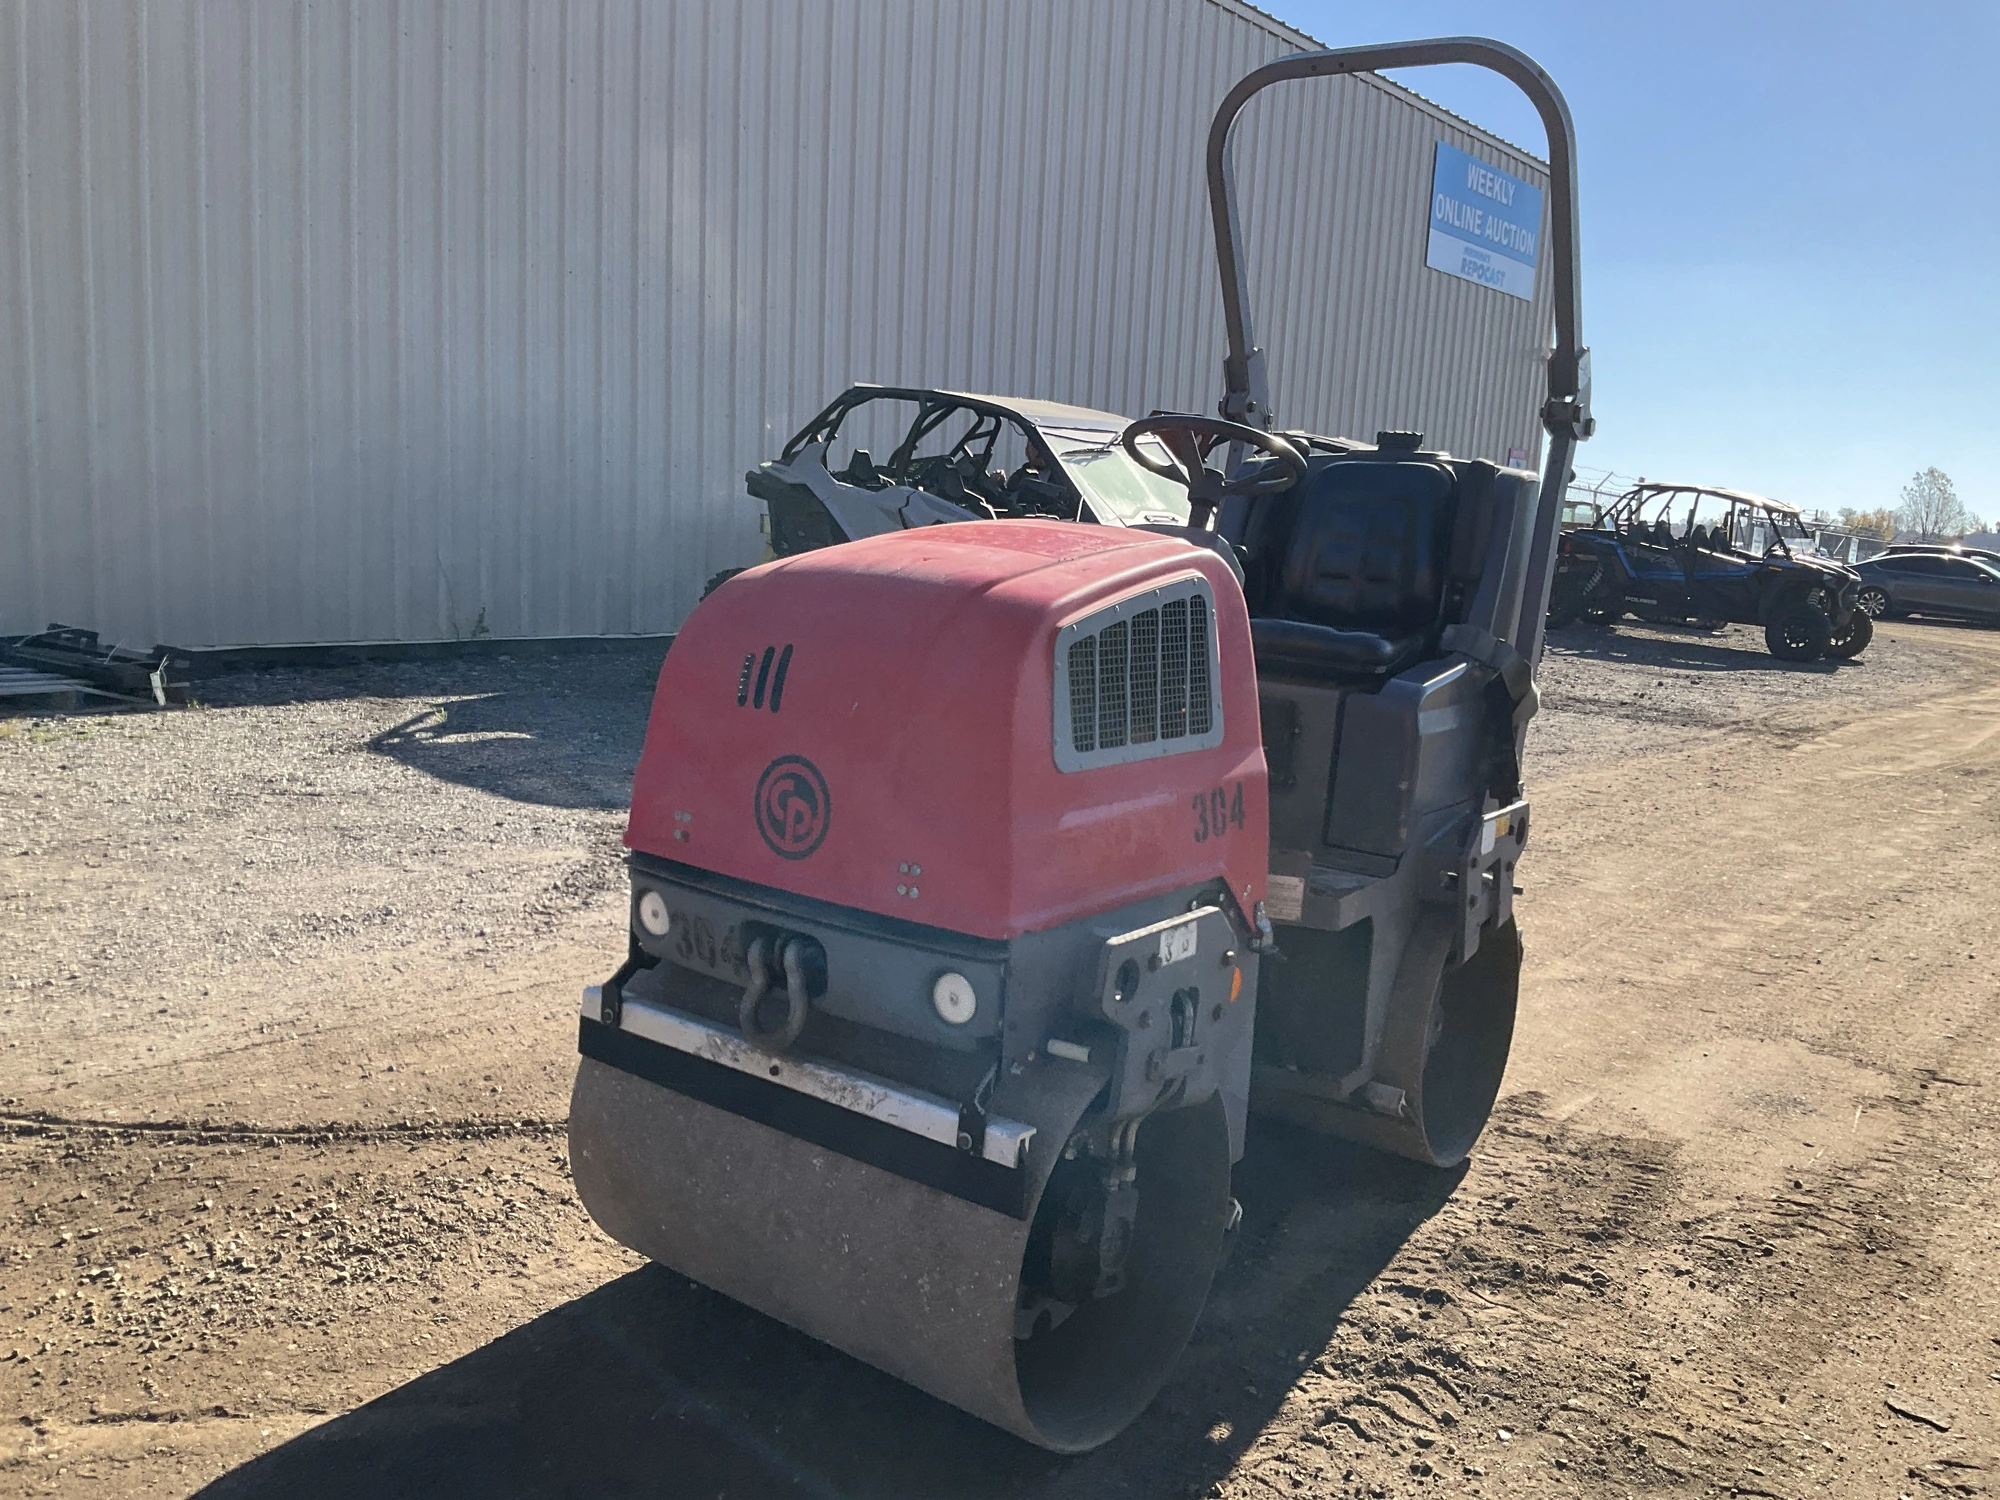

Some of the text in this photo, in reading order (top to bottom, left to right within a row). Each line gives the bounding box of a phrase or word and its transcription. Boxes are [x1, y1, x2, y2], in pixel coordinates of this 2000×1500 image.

[1467, 163, 1516, 207] WEEKLY
[1435, 193, 1483, 235] ONLINE
[1485, 215, 1535, 256] AUCTION
[1461, 257, 1506, 287] REPOCAST
[1192, 781, 1246, 843] 304
